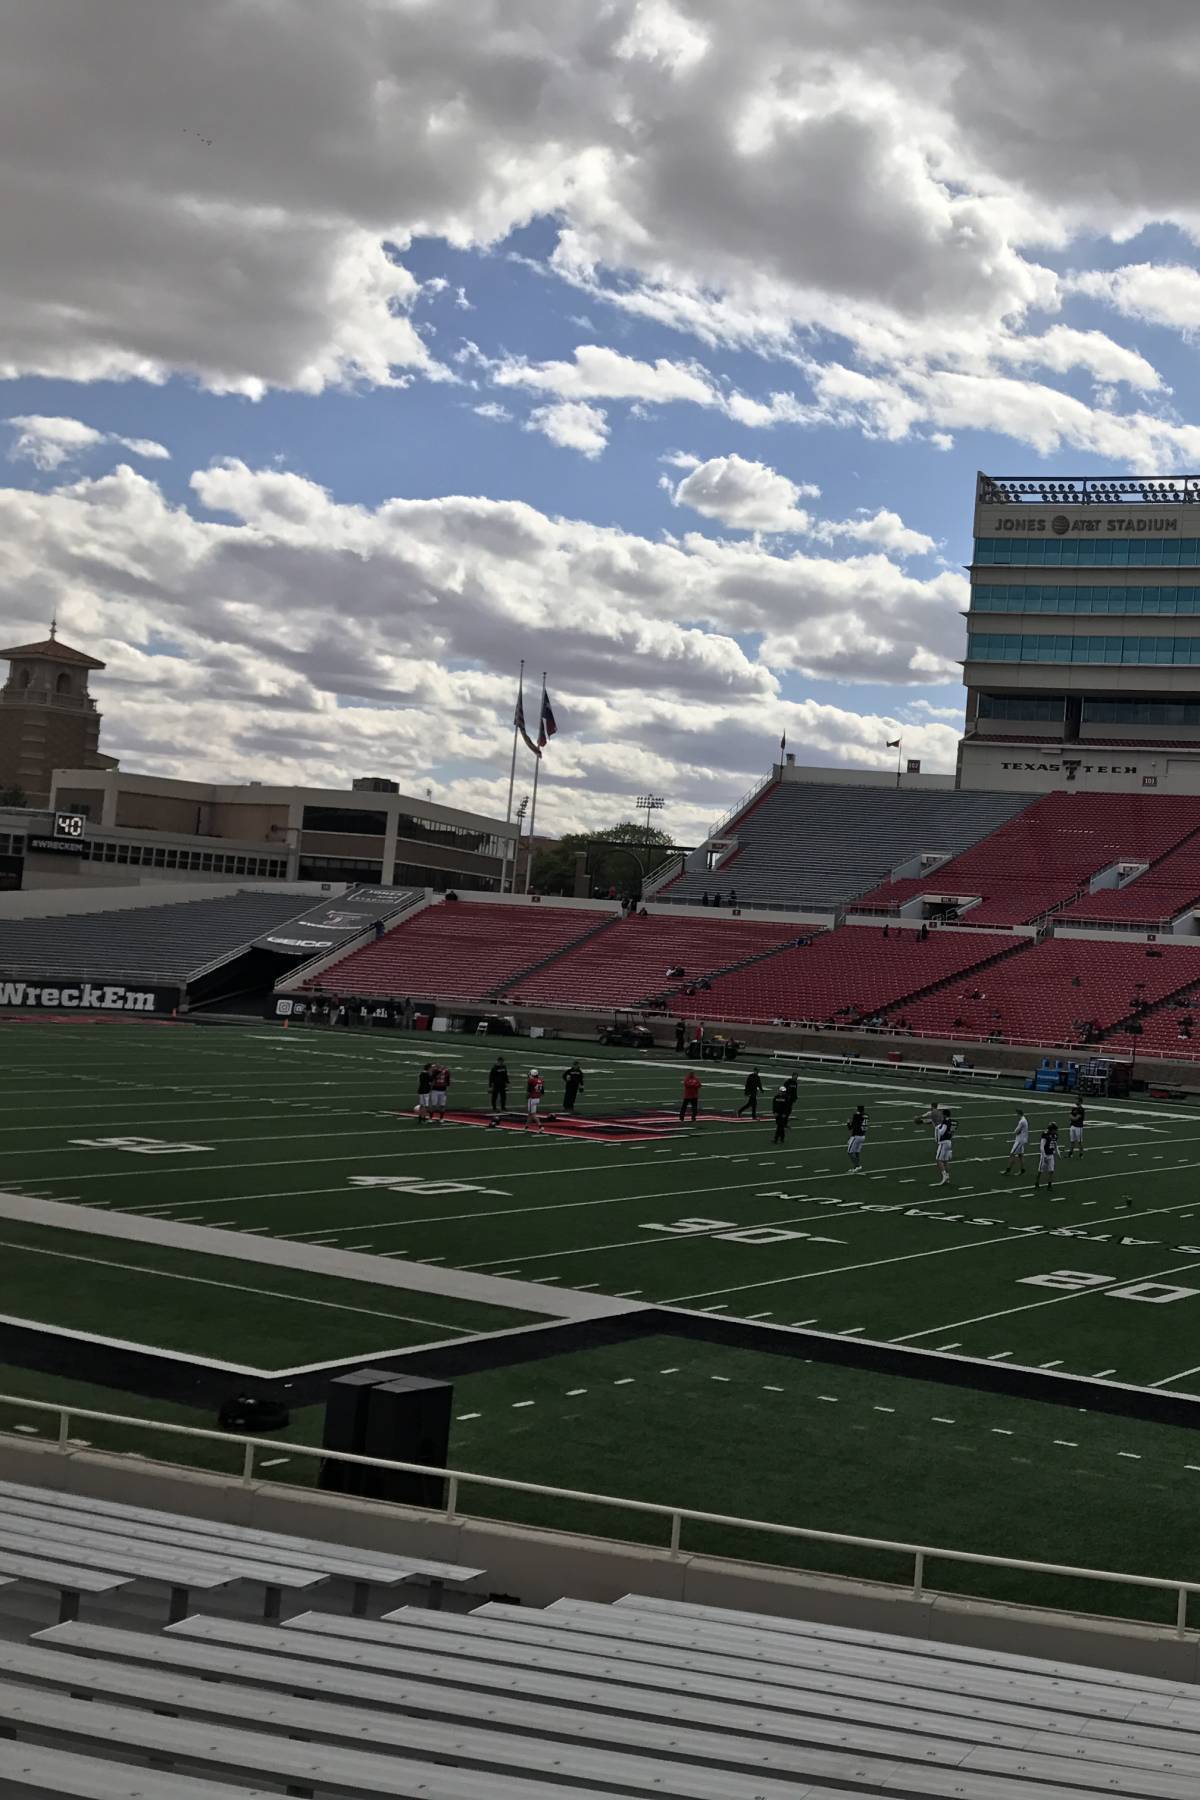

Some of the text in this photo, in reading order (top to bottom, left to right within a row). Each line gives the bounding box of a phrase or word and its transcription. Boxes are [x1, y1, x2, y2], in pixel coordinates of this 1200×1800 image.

[994, 518, 1177, 532] JONES AT&T STADIUM
[1001, 762, 1060, 772] TEXAS
[1083, 766, 1137, 774] TECH
[58, 817, 82, 836] 40
[266, 937, 334, 948] GEICO
[0, 982, 155, 1011] WreckEm
[637, 1217, 812, 1244] 30
